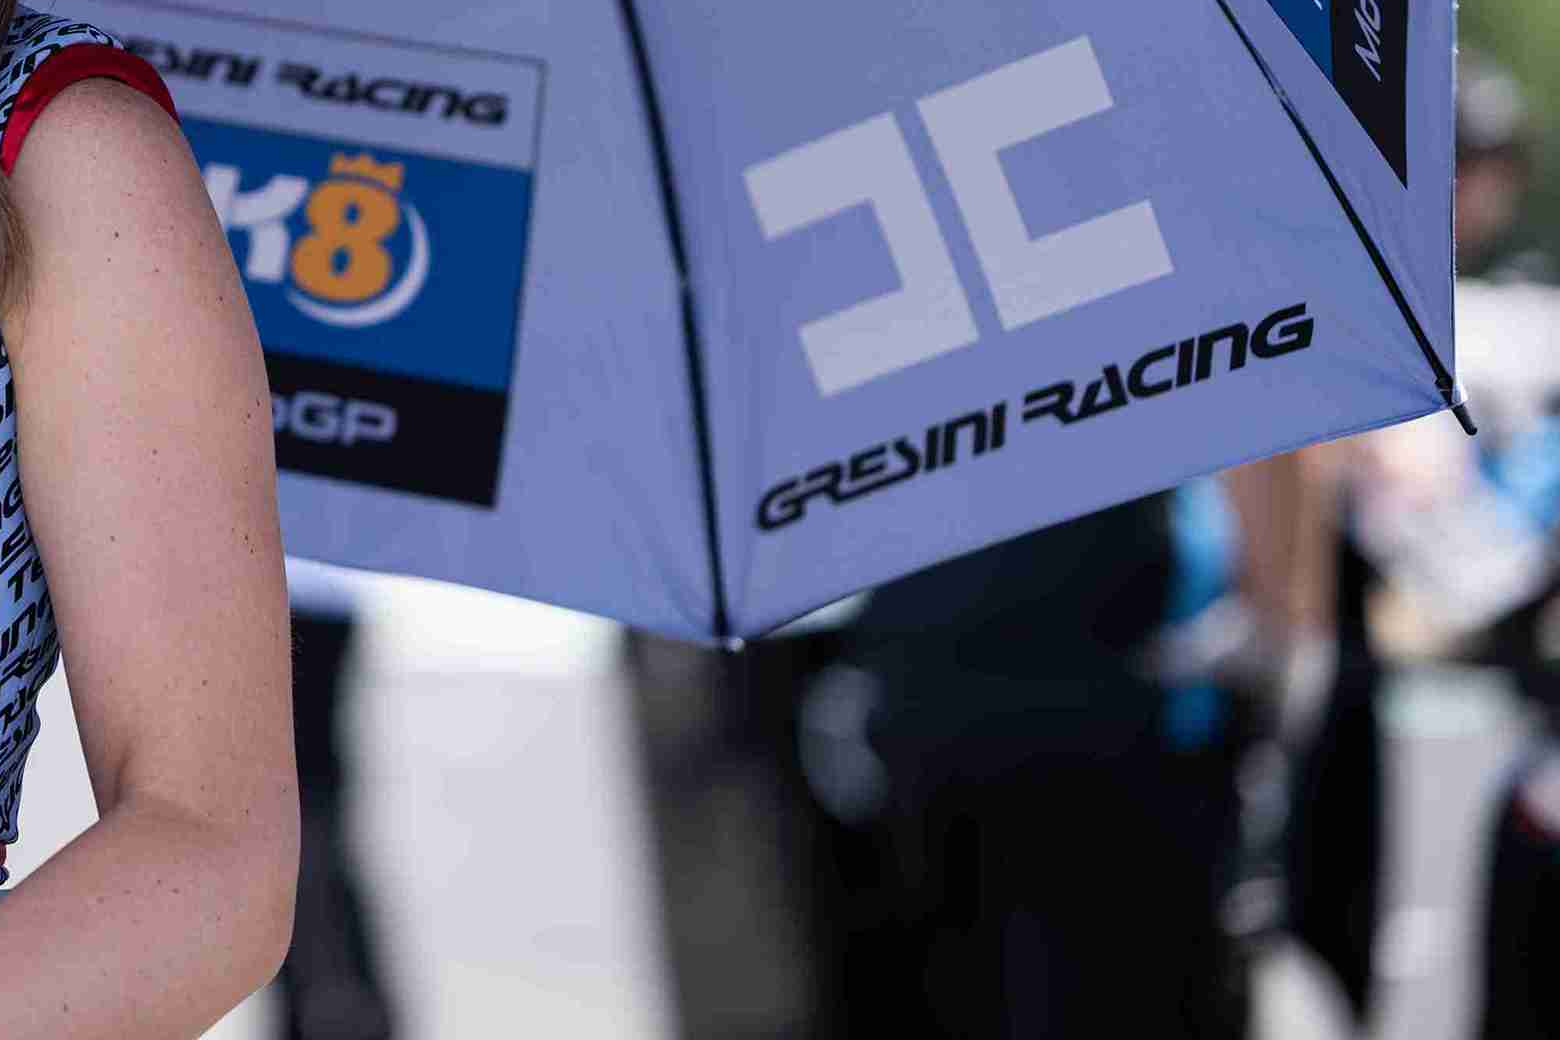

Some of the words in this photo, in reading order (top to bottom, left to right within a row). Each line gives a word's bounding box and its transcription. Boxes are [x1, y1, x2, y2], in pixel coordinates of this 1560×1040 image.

[275, 63, 510, 127] RACING
[200, 161, 400, 304] K8
[754, 400, 1008, 533] GRESINI
[1021, 302, 1315, 426] RACING
